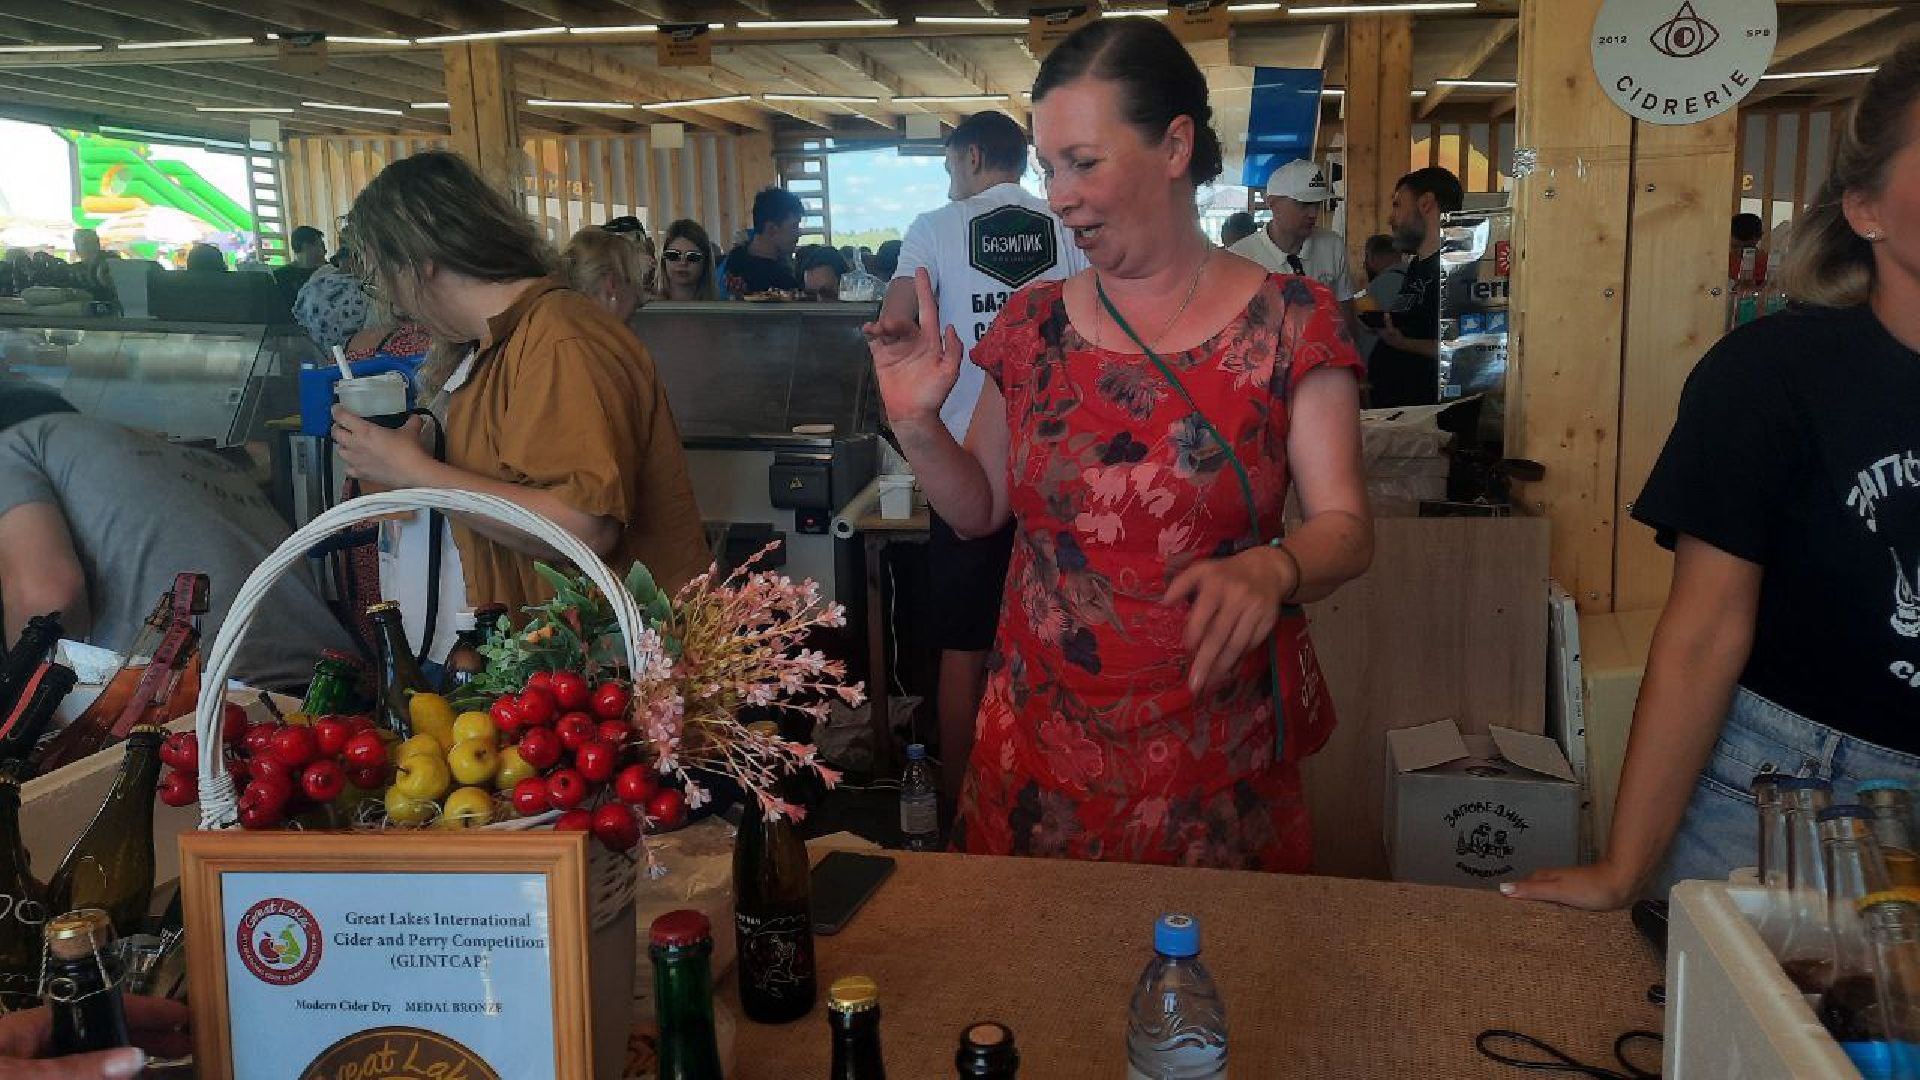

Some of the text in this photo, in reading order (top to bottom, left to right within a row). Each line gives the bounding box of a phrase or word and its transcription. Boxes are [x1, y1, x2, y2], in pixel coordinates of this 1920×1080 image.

[1598, 35, 1628, 44] 2012
[1616, 69, 1750, 115] CIDRERIE
[981, 233, 1043, 253] БАЗИЛИК
[1443, 801, 1530, 834] ЗАПОВЕДНИК
[345, 911, 531, 928] Great Lakes International
[333, 932, 546, 952] Cider and Perry Competition
[390, 953, 490, 970] (GLINTCAP)
[296, 999, 504, 1015] Modern Cider Dry MEDAL BRONZE
